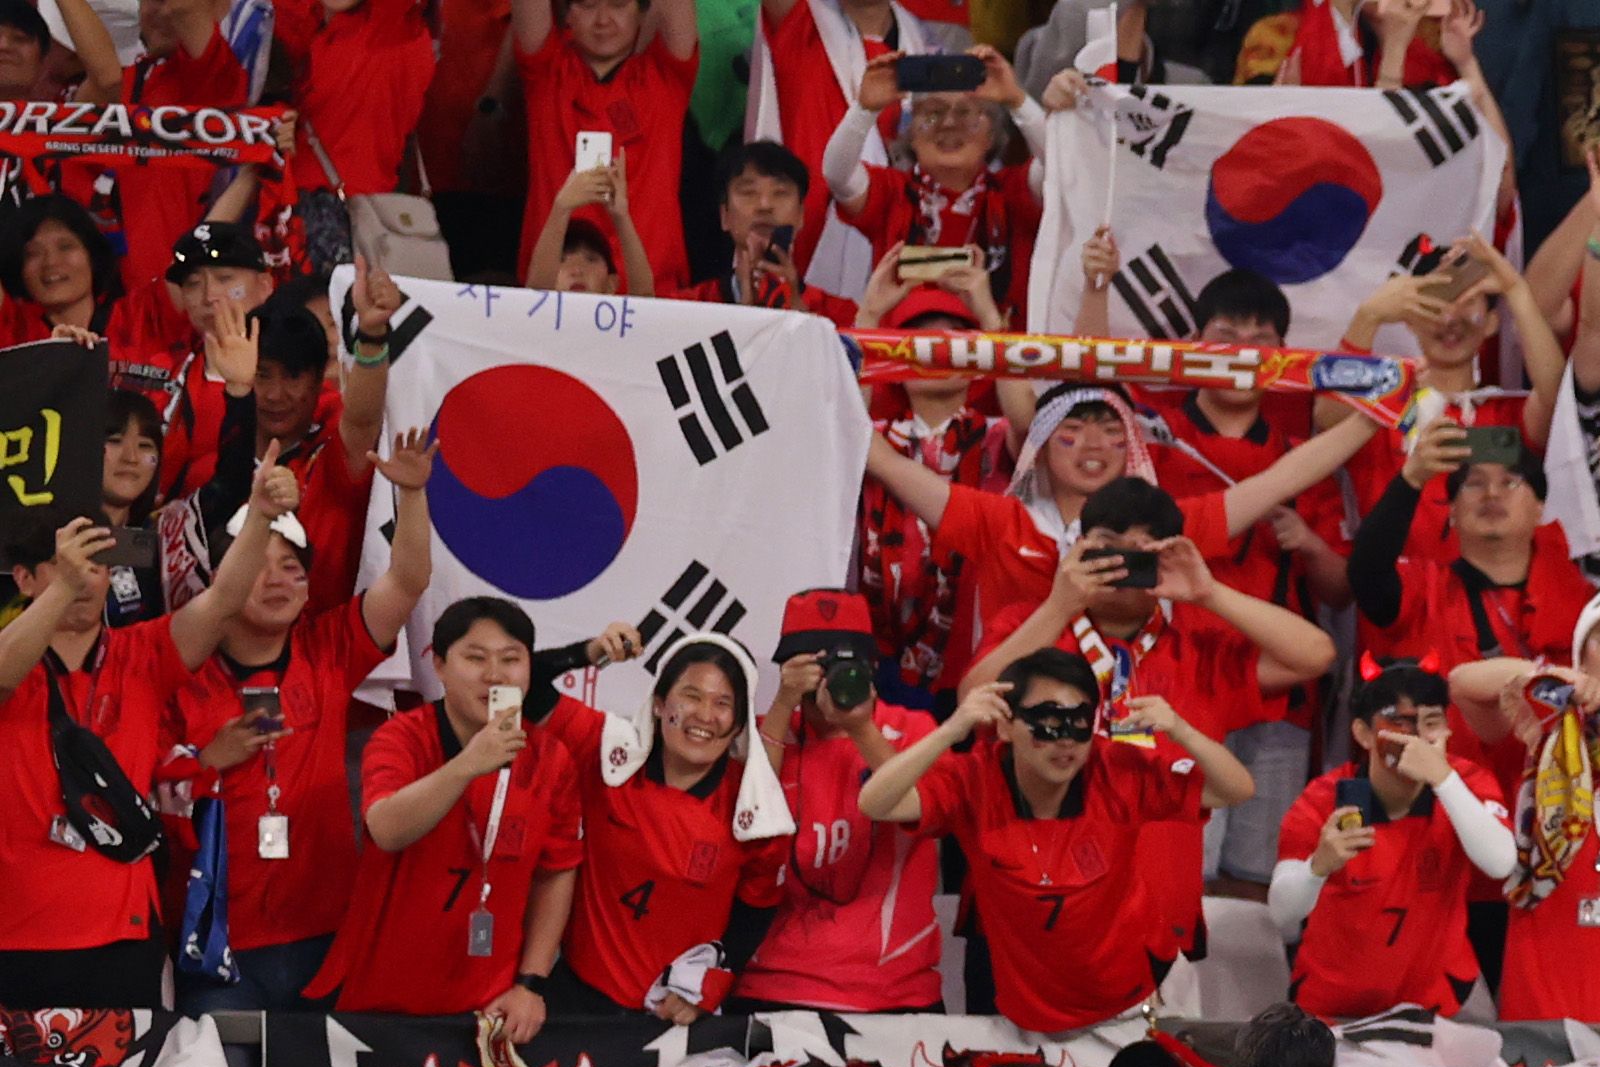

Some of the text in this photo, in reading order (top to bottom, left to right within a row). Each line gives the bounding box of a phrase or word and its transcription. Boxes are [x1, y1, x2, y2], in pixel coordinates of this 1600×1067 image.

[149, 105, 281, 146] COR
[813, 819, 850, 869] 18
[443, 868, 472, 912] 7
[619, 879, 656, 921] 4
[1036, 894, 1066, 932] 7
[1381, 907, 1409, 948] 7
